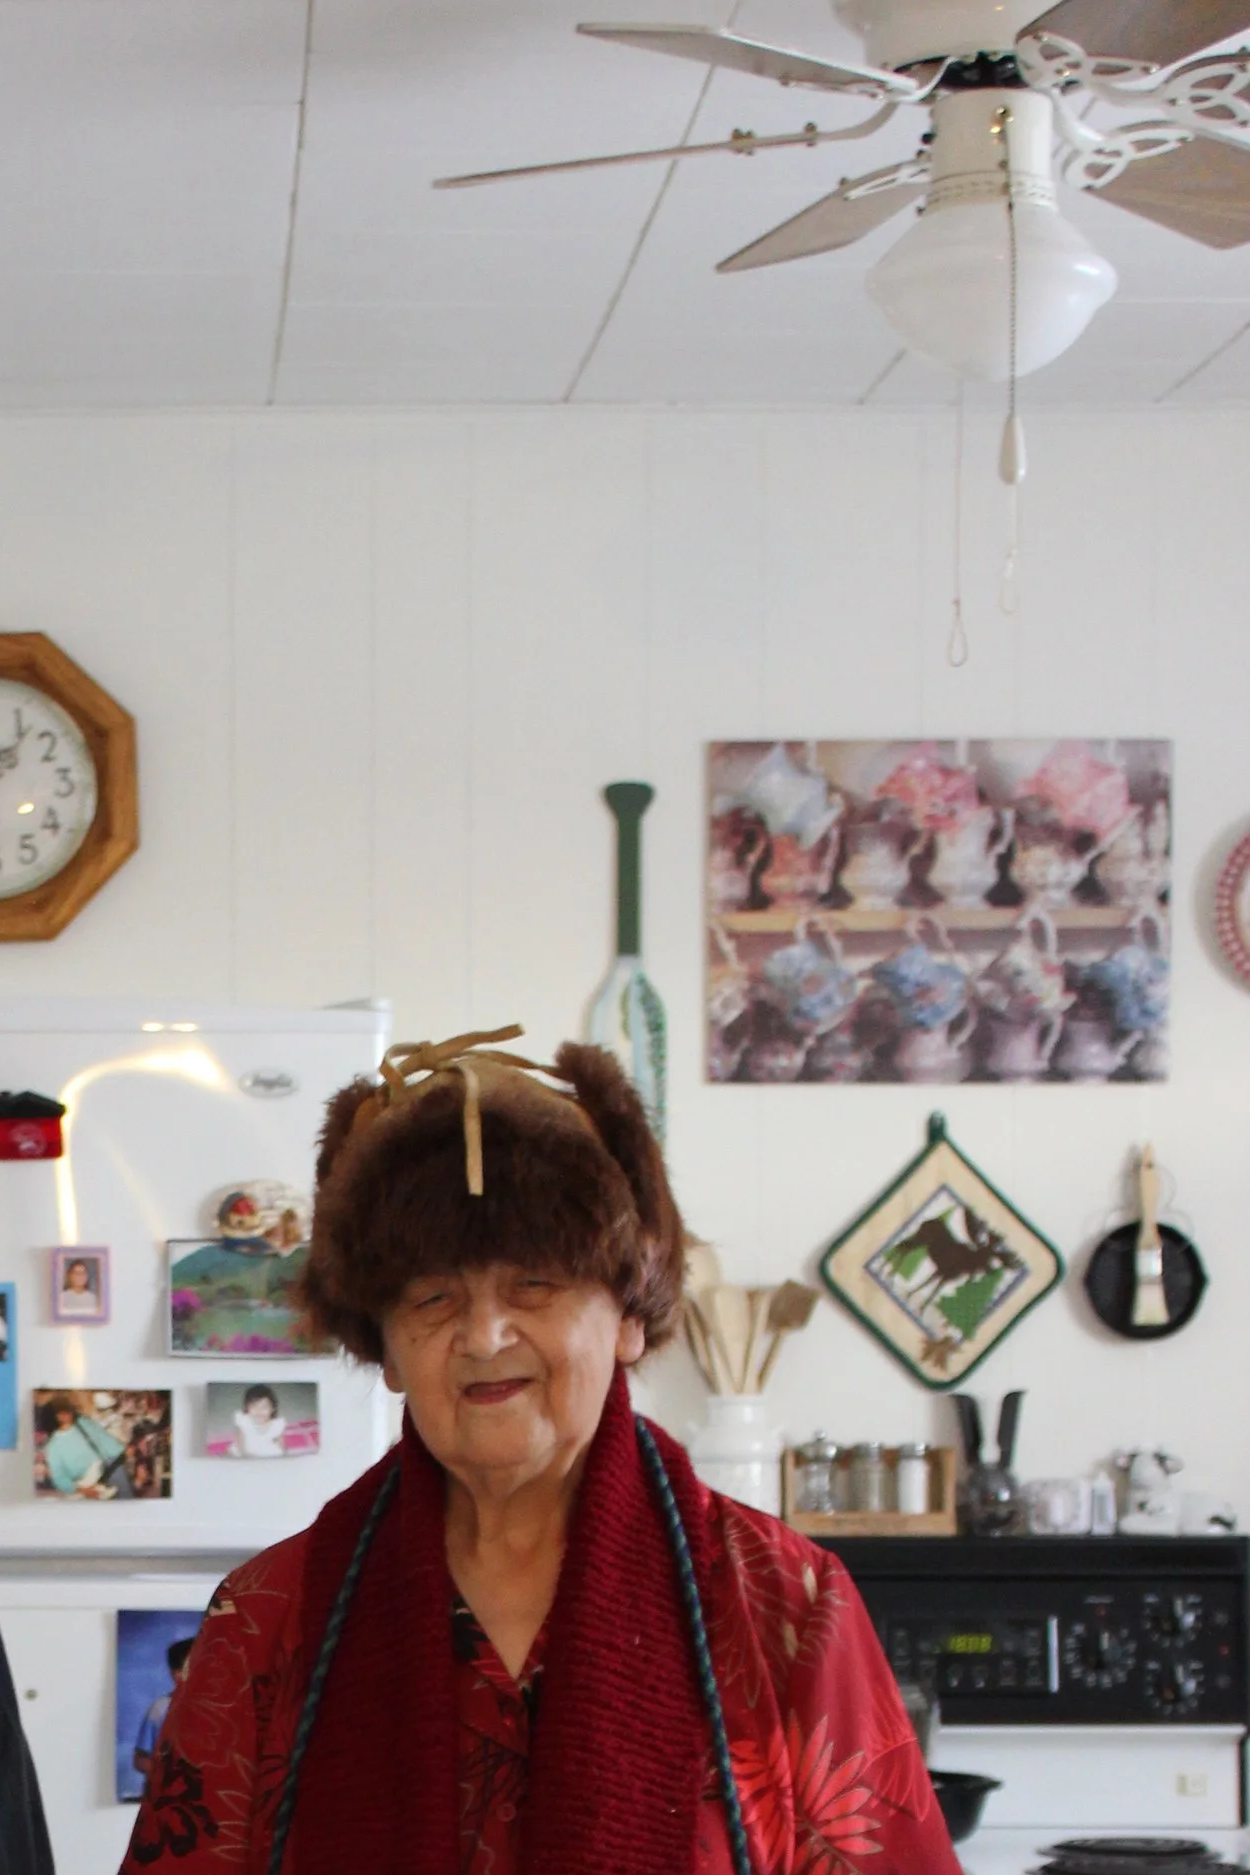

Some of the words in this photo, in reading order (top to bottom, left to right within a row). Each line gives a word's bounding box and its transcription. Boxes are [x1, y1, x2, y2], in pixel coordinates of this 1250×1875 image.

[38, 732, 57, 763] 2
[54, 768, 74, 798] 3
[41, 808, 60, 837] 4
[19, 834, 38, 865] 5
